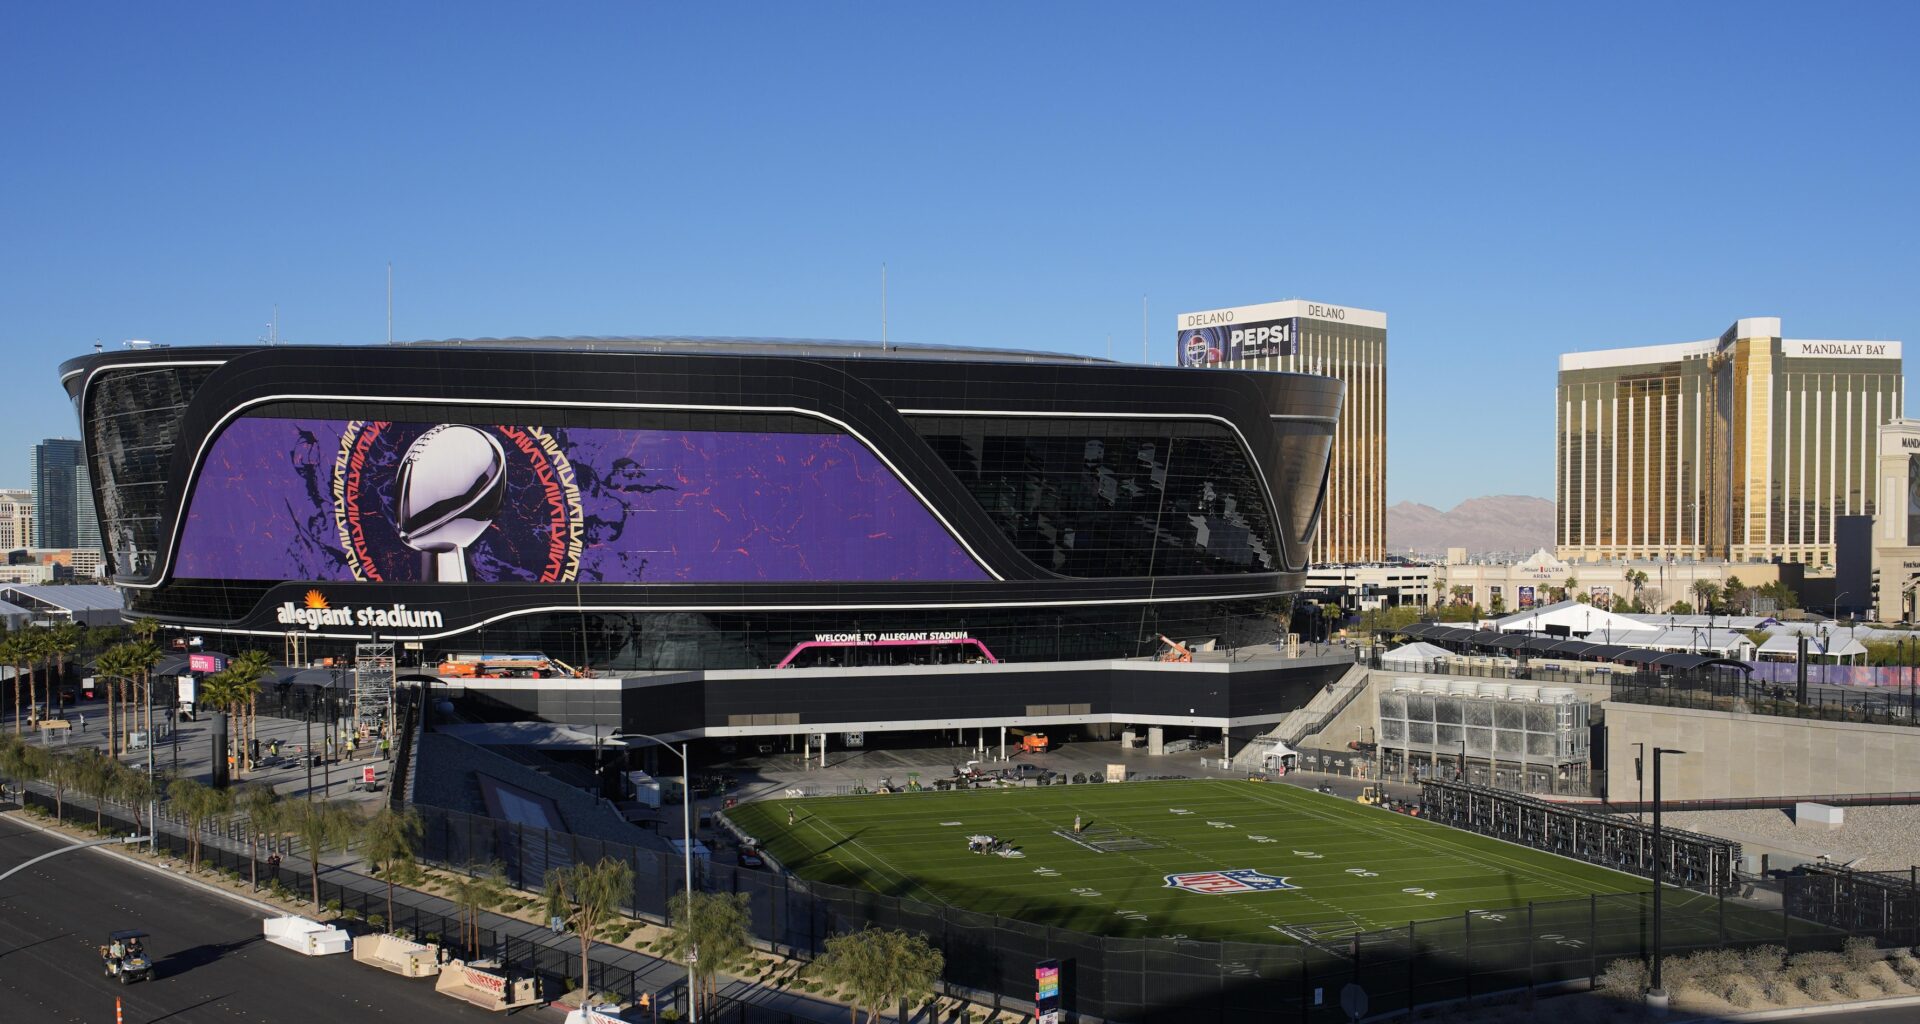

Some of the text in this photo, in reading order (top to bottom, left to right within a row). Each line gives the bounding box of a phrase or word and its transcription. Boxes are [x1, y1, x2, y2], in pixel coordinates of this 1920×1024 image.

[1188, 311, 1234, 327] DELANO
[1308, 304, 1345, 320] DELANO
[1231, 324, 1289, 347] PEPSI
[1188, 344, 1206, 352] PEPSI
[1801, 343, 1886, 354] MANDALAY BAY
[276, 602, 443, 630] allegiant stadium
[815, 631, 968, 642] WELCOME TO ALLEGIANT STADIUM
[191, 660, 208, 669] SOUTH
[1178, 873, 1248, 892] NFL
[476, 974, 502, 987] STOP
